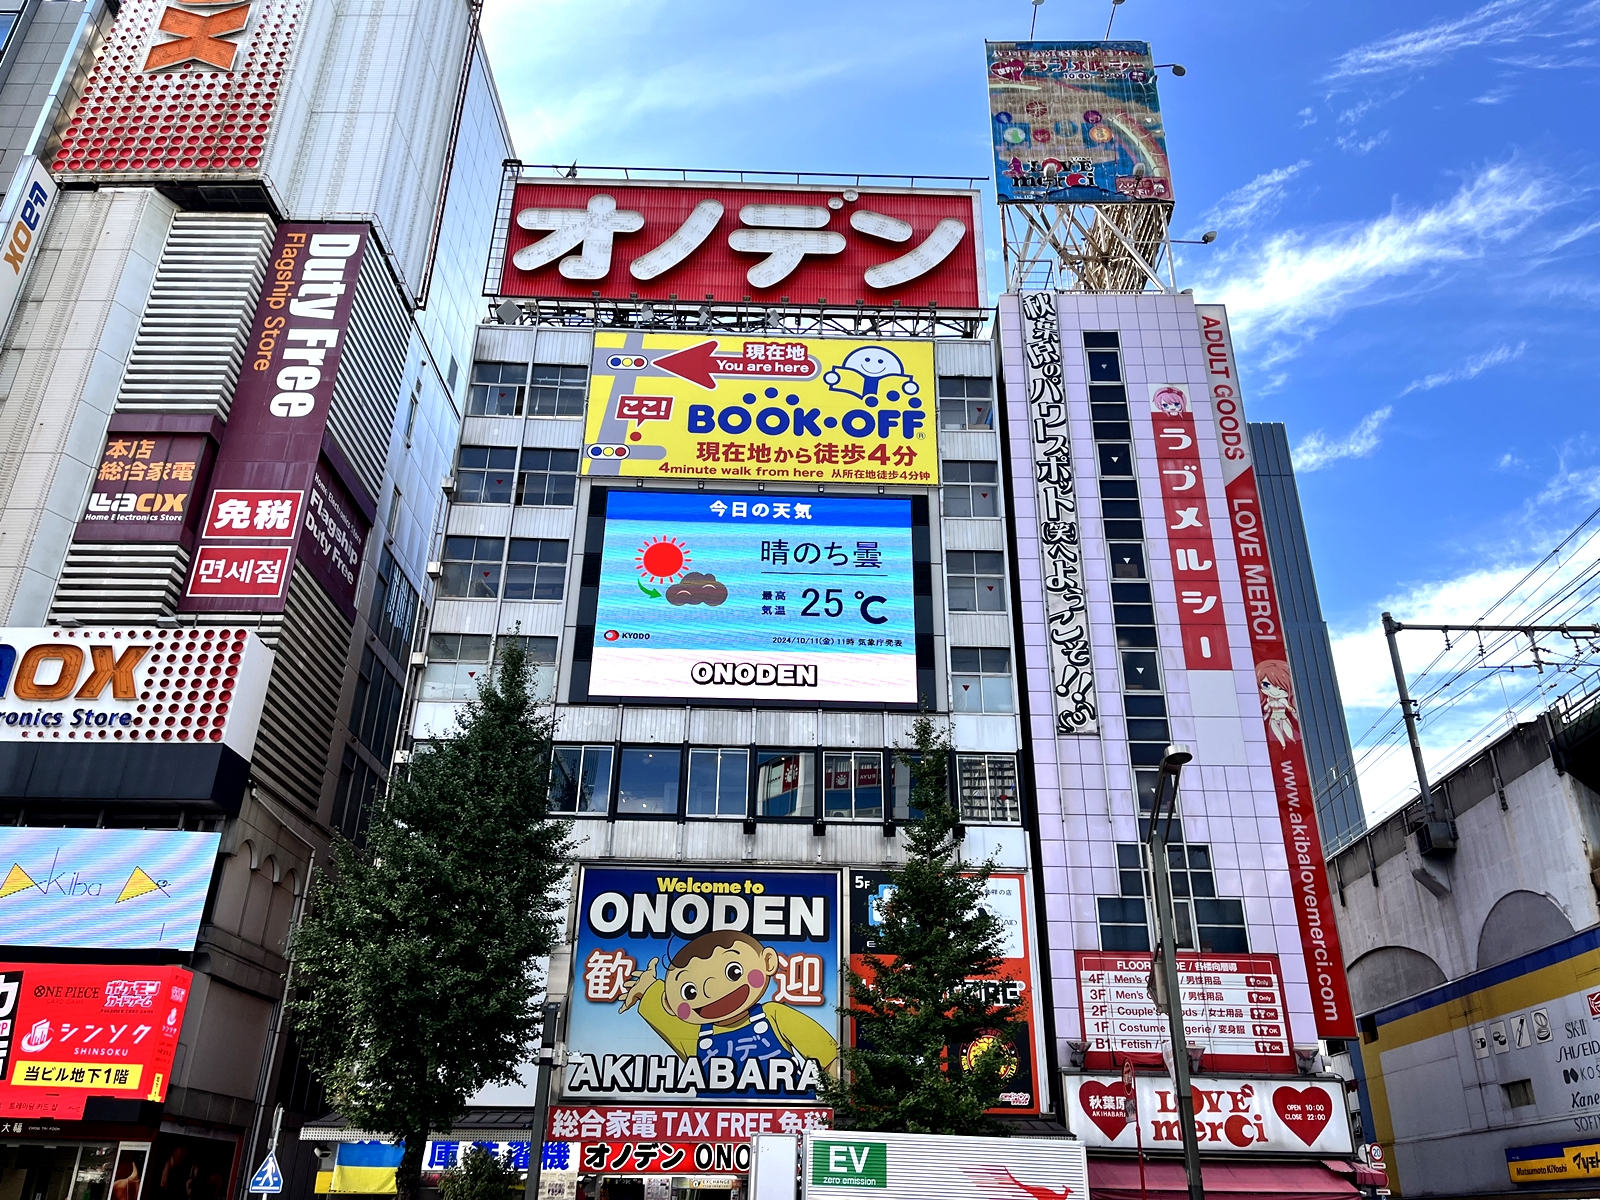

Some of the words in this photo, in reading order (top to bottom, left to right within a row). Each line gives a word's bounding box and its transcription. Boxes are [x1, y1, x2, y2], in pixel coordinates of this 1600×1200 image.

[512, 190, 966, 289] オノデン
[265, 232, 306, 310] Flagship
[289, 233, 360, 320] Duty
[253, 316, 285, 371] Store
[746, 343, 806, 361] 現在地
[1201, 315, 1231, 378] ADULT
[269, 328, 340, 418] Free
[717, 360, 744, 373] You
[747, 363, 773, 373] are
[775, 361, 809, 374] here
[1213, 384, 1245, 460] GOODS
[105, 439, 156, 459] 本店
[696, 441, 918, 467] 現在地から徒歩4分
[97, 461, 196, 482] 総合家電
[658, 462, 717, 476] 4minute
[720, 465, 751, 476] walk
[755, 466, 790, 477] from
[793, 467, 825, 478] here
[85, 514, 111, 522] Home
[112, 514, 158, 522] Electronics
[160, 514, 183, 522] Store
[212, 498, 293, 530] 免税
[709, 500, 813, 520] 今日の天気
[310, 487, 358, 566] Flagship
[1233, 498, 1262, 557] LOVE
[305, 510, 332, 556] Duty
[331, 546, 355, 585] Free
[1160, 428, 1218, 658] ラブメルシー
[760, 540, 883, 569] 晴のち曇
[198, 558, 282, 584] 면세점
[761, 590, 786, 601] 最高
[800, 588, 843, 617] 25
[1243, 564, 1277, 640] MERCI
[761, 604, 786, 616] 気温
[622, 632, 650, 640] KYODO
[691, 661, 818, 687] ONODEN
[70, 708, 133, 727] Store
[657, 877, 741, 894] Welcome
[744, 880, 764, 894] to
[855, 875, 870, 889] 5F
[1280, 760, 1339, 1021] www.akibalovemerci.com
[588, 891, 826, 938] ONODEN
[1116, 960, 1151, 970] FLOOR
[105, 980, 161, 997] ポケモン
[1088, 973, 1105, 984] 4F
[1114, 975, 1142, 984] Men's
[34, 985, 63, 998] ONE
[64, 986, 101, 999] PIECE
[1090, 989, 1106, 1000] 3F
[1115, 990, 1144, 1000] Men's
[1091, 1005, 1107, 1017] 2F
[1117, 1006, 1161, 1017] Couple's
[59, 1023, 152, 1044] シンソク
[1094, 1021, 1109, 1033] 1F
[1119, 1023, 1166, 1032] Costume
[1565, 1019, 1588, 1039] SK-II
[73, 1047, 129, 1057] SHINSOKU
[1095, 1038, 1111, 1049] B1
[1120, 1039, 1152, 1049] Fetish
[24, 1065, 130, 1085] 当ビル地下1階
[569, 1053, 820, 1093] AKIHABARA
[1088, 1095, 1126, 1111] 秋葉原
[552, 1109, 659, 1139] 総合家電
[661, 1111, 711, 1138] TAX
[716, 1111, 774, 1139] FREE
[1306, 1113, 1326, 1121] 22:00
[1574, 1114, 1600, 1133] SOFI
[584, 1142, 686, 1171] オノデン
[829, 1145, 870, 1173] EV
[823, 1177, 840, 1186] zero
[842, 1176, 877, 1186] emission
[1516, 1166, 1547, 1176] Matsumoto
